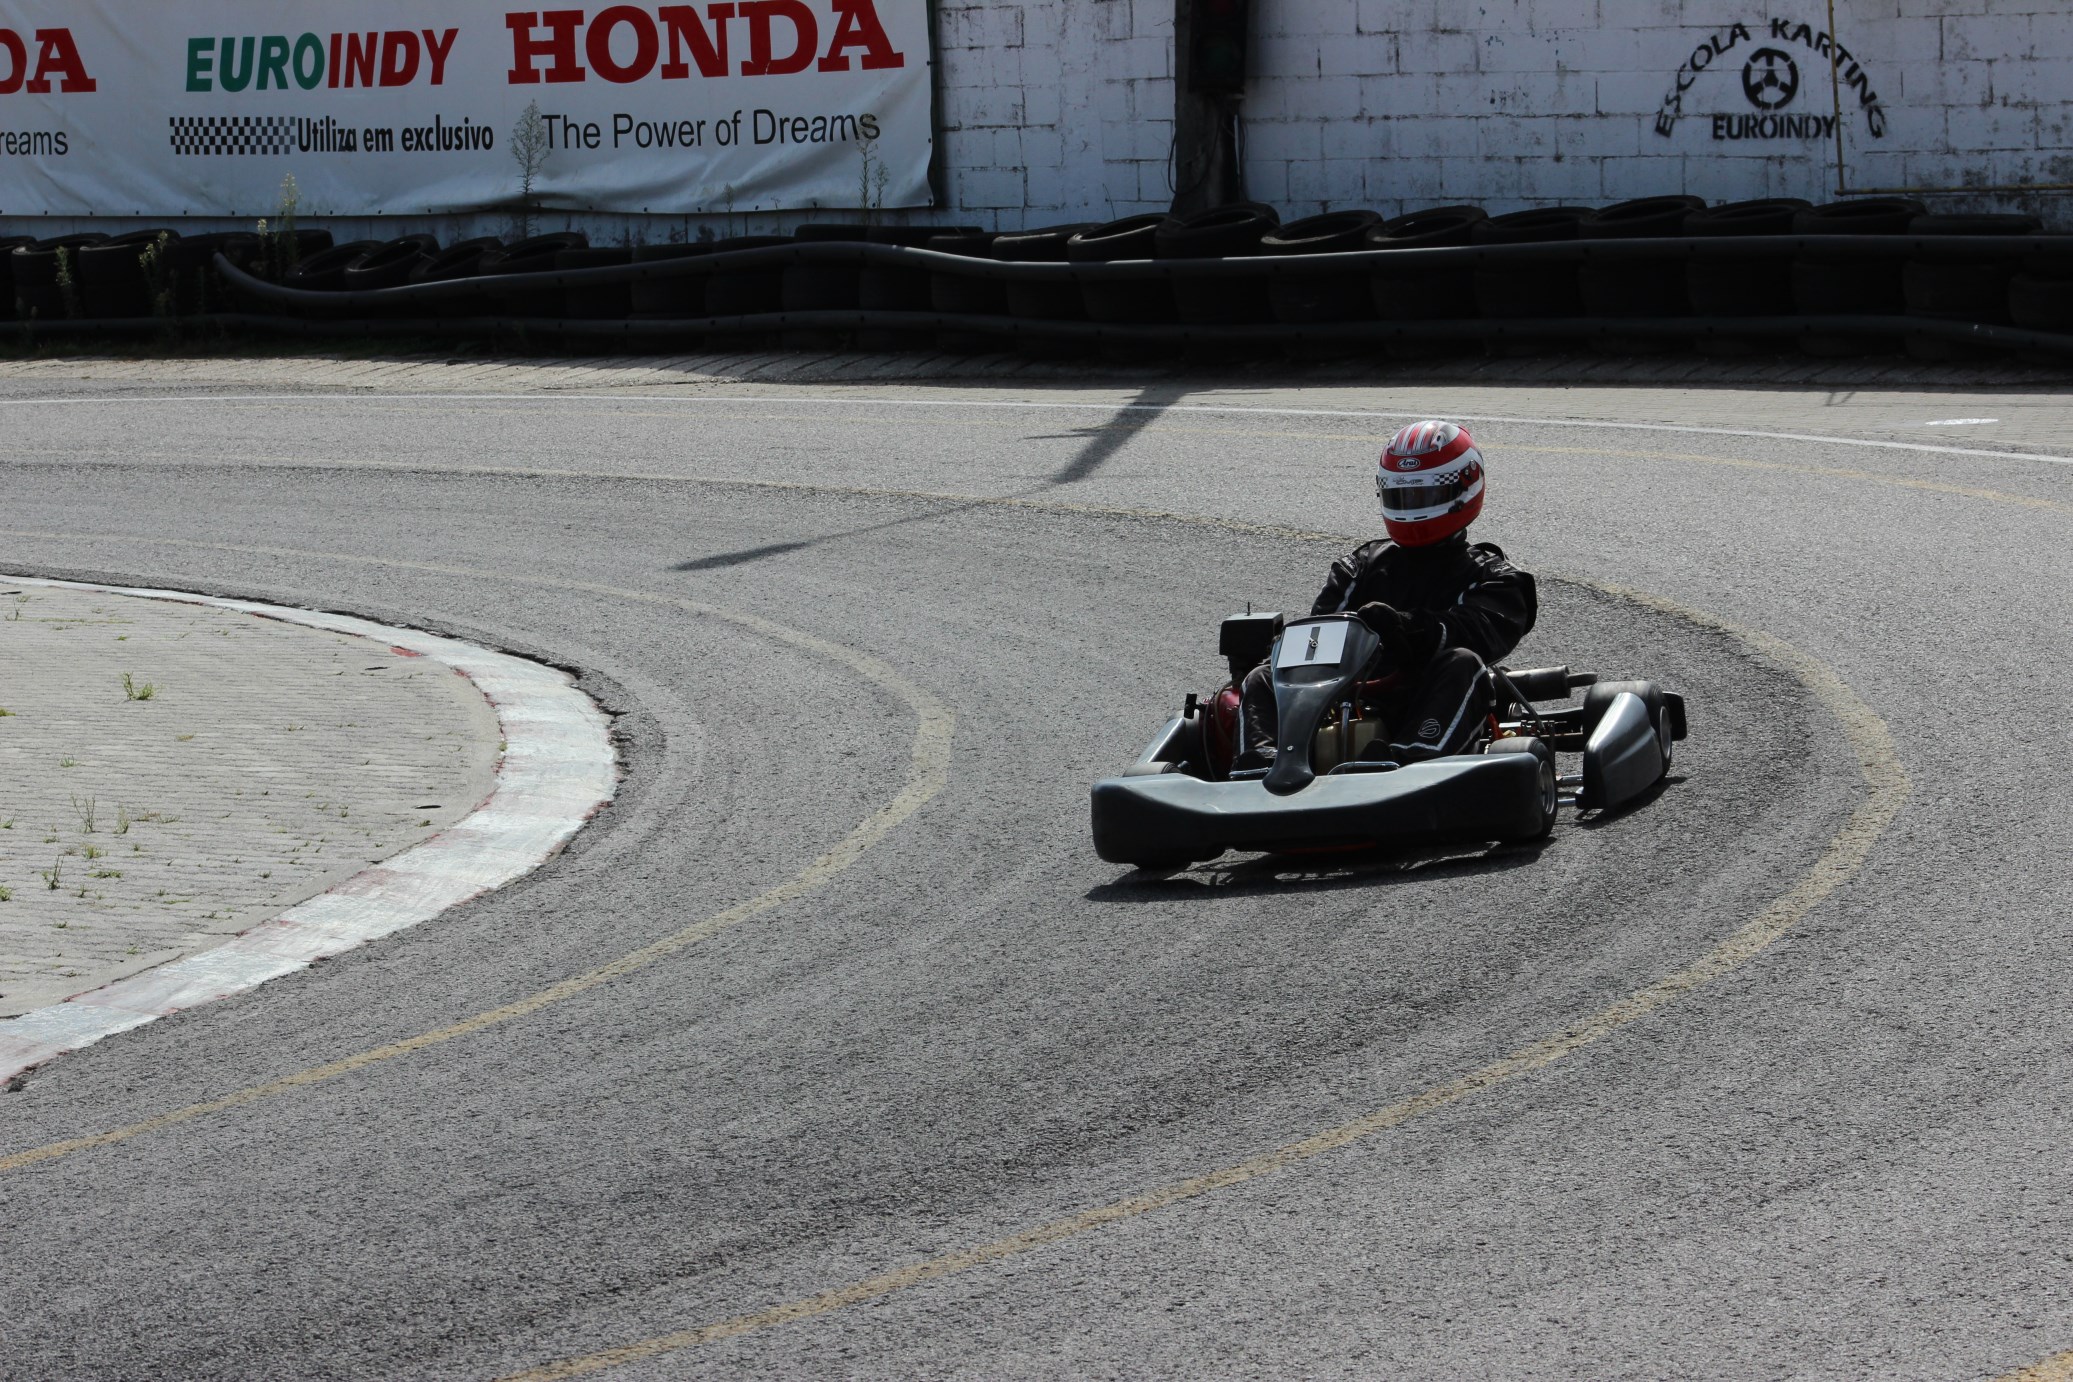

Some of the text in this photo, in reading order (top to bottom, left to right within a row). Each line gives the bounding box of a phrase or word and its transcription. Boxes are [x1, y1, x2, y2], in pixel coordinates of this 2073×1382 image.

[186, 28, 459, 93] EUROINDY
[505, 0, 904, 84] HONDA
[1655, 17, 1886, 139] ESCOLA KARTING
[298, 114, 494, 153] Utiliza em exclusivo
[541, 108, 881, 149] The Power of Dreams
[1712, 113, 1837, 140] EUROINDY
[1399, 458, 1419, 468] Arai
